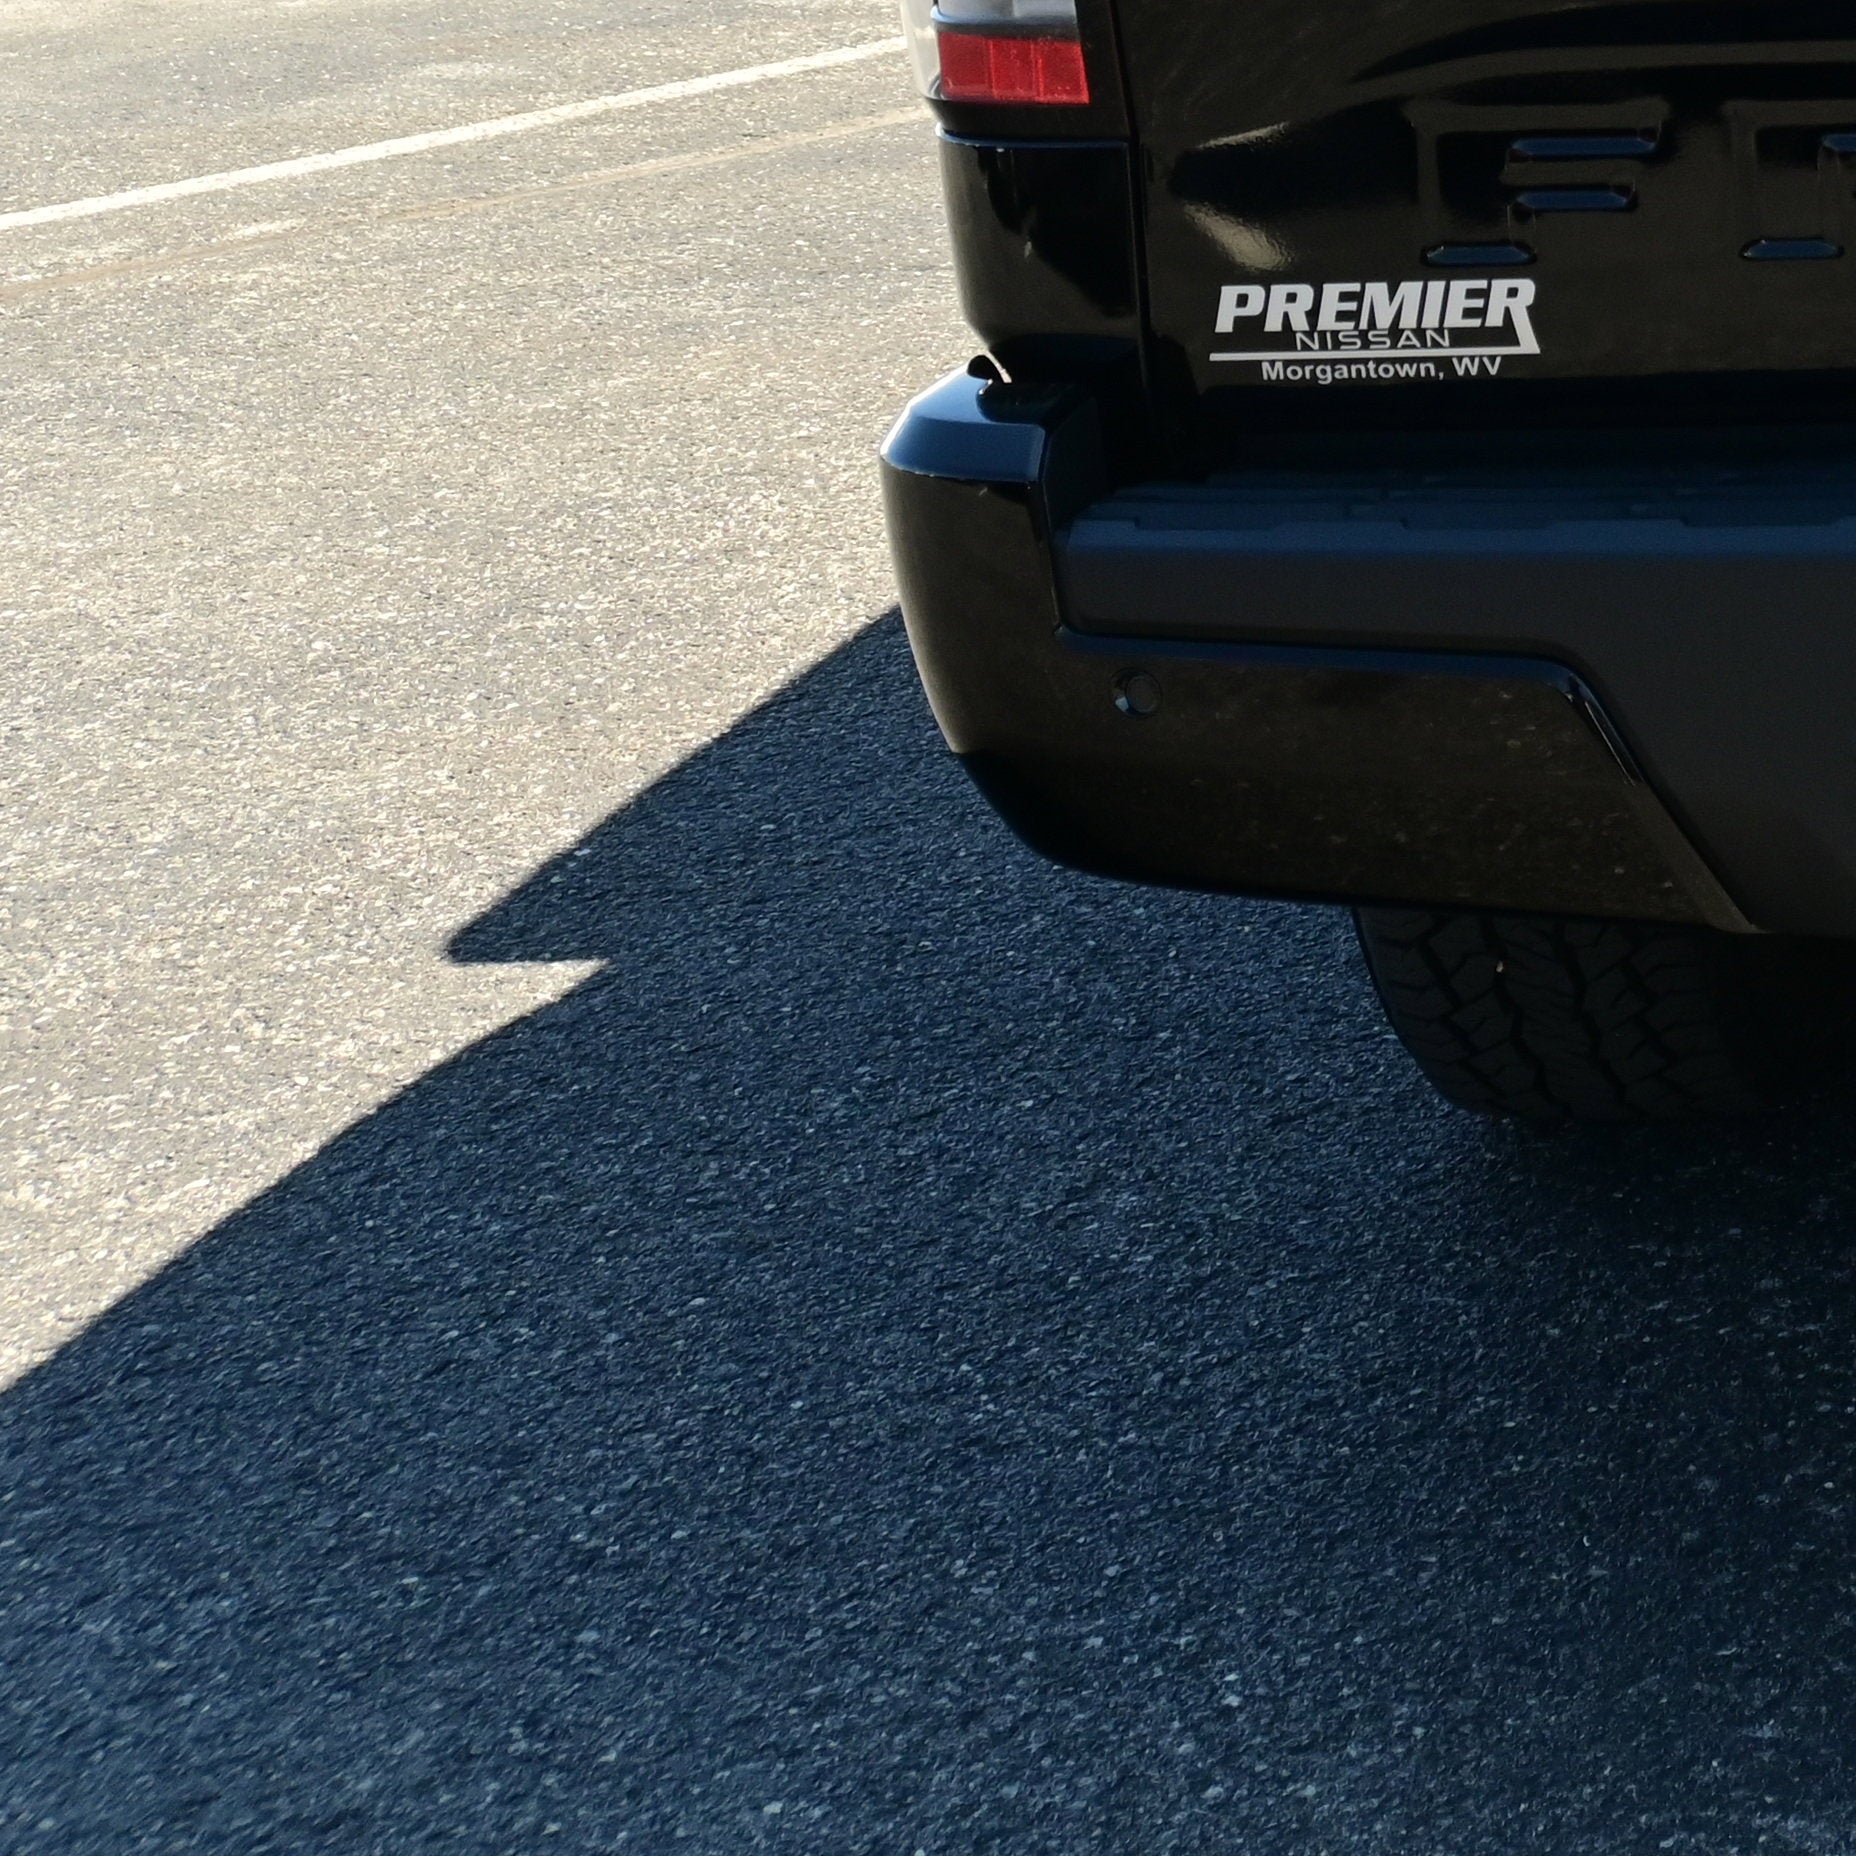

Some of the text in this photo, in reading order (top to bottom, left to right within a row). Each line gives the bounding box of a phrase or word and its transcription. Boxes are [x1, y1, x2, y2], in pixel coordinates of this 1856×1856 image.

[1214, 278, 1541, 354] PREMIER
[1295, 329, 1451, 351] NISSAN
[1261, 356, 1503, 385] Morgantown, WV
